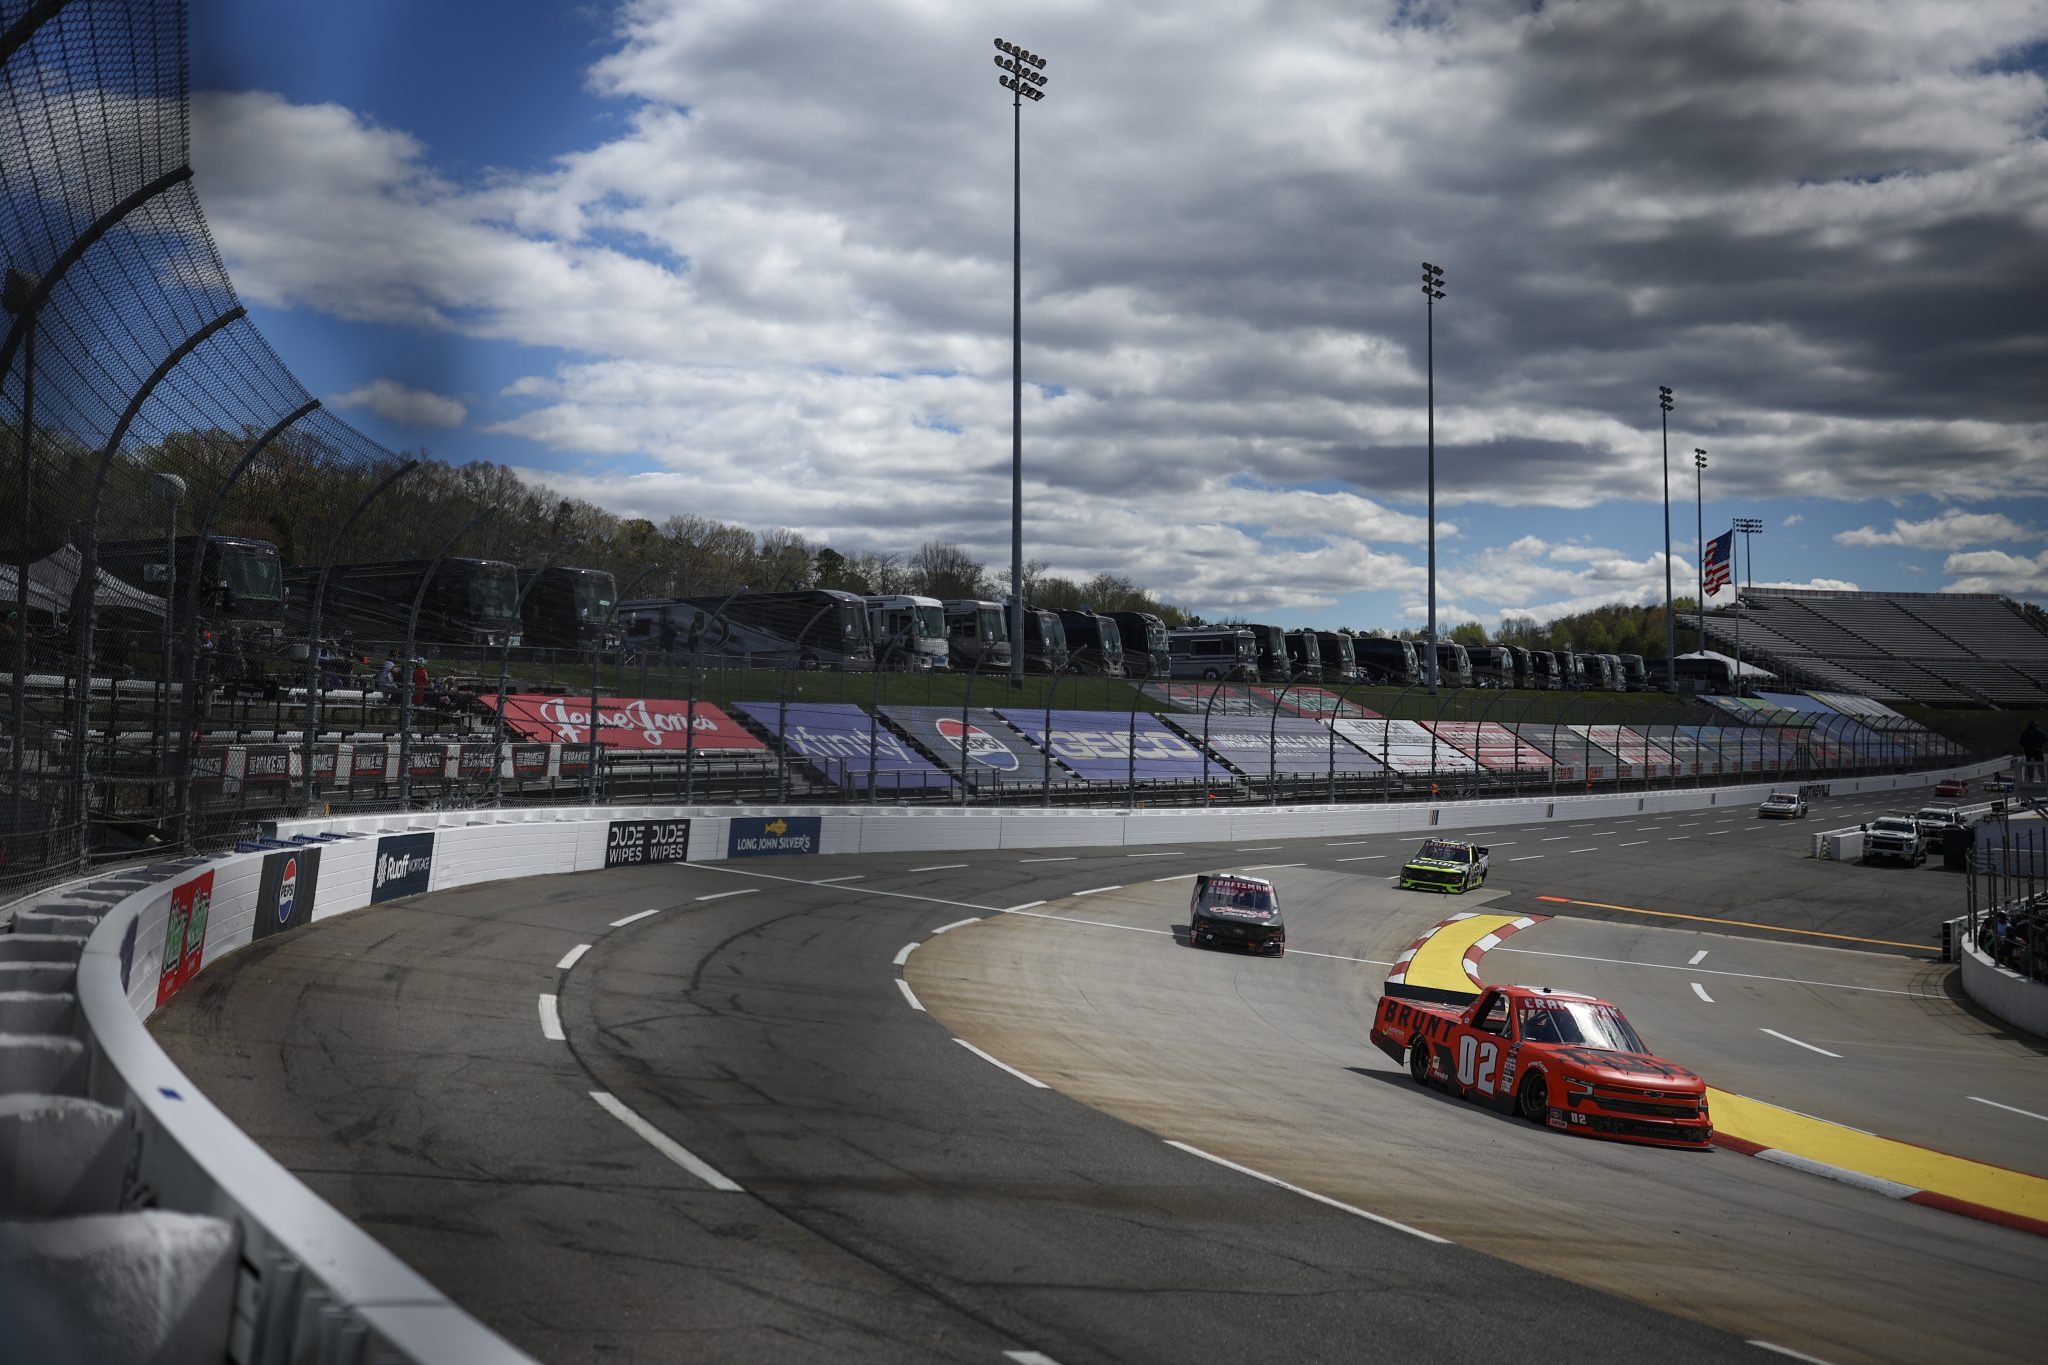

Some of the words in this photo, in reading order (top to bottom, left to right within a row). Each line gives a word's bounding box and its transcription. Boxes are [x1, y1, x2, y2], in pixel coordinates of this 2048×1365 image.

[1036, 731, 1200, 760] GEICO
[610, 825, 645, 847] DUDE
[650, 824, 686, 844] DUDE
[239, 844, 257, 852] LONG
[264, 840, 282, 848] LONG
[649, 844, 684, 860] WIPES
[737, 837, 758, 851] LONG
[757, 837, 779, 851] JOHN
[778, 834, 811, 853] SILVER'S
[609, 847, 643, 864] WIPES
[386, 852, 410, 881] Ruoff
[280, 883, 295, 899] PEPSI
[1212, 880, 1269, 893] CRAFTSMAN
[1524, 998, 1620, 1019] CRAFMAN
[1384, 1000, 1457, 1043] BRUNT
[1457, 1034, 1499, 1096] 02
[1527, 1060, 1549, 1073] GOODYEAR
[1570, 1112, 1587, 1125] 02
